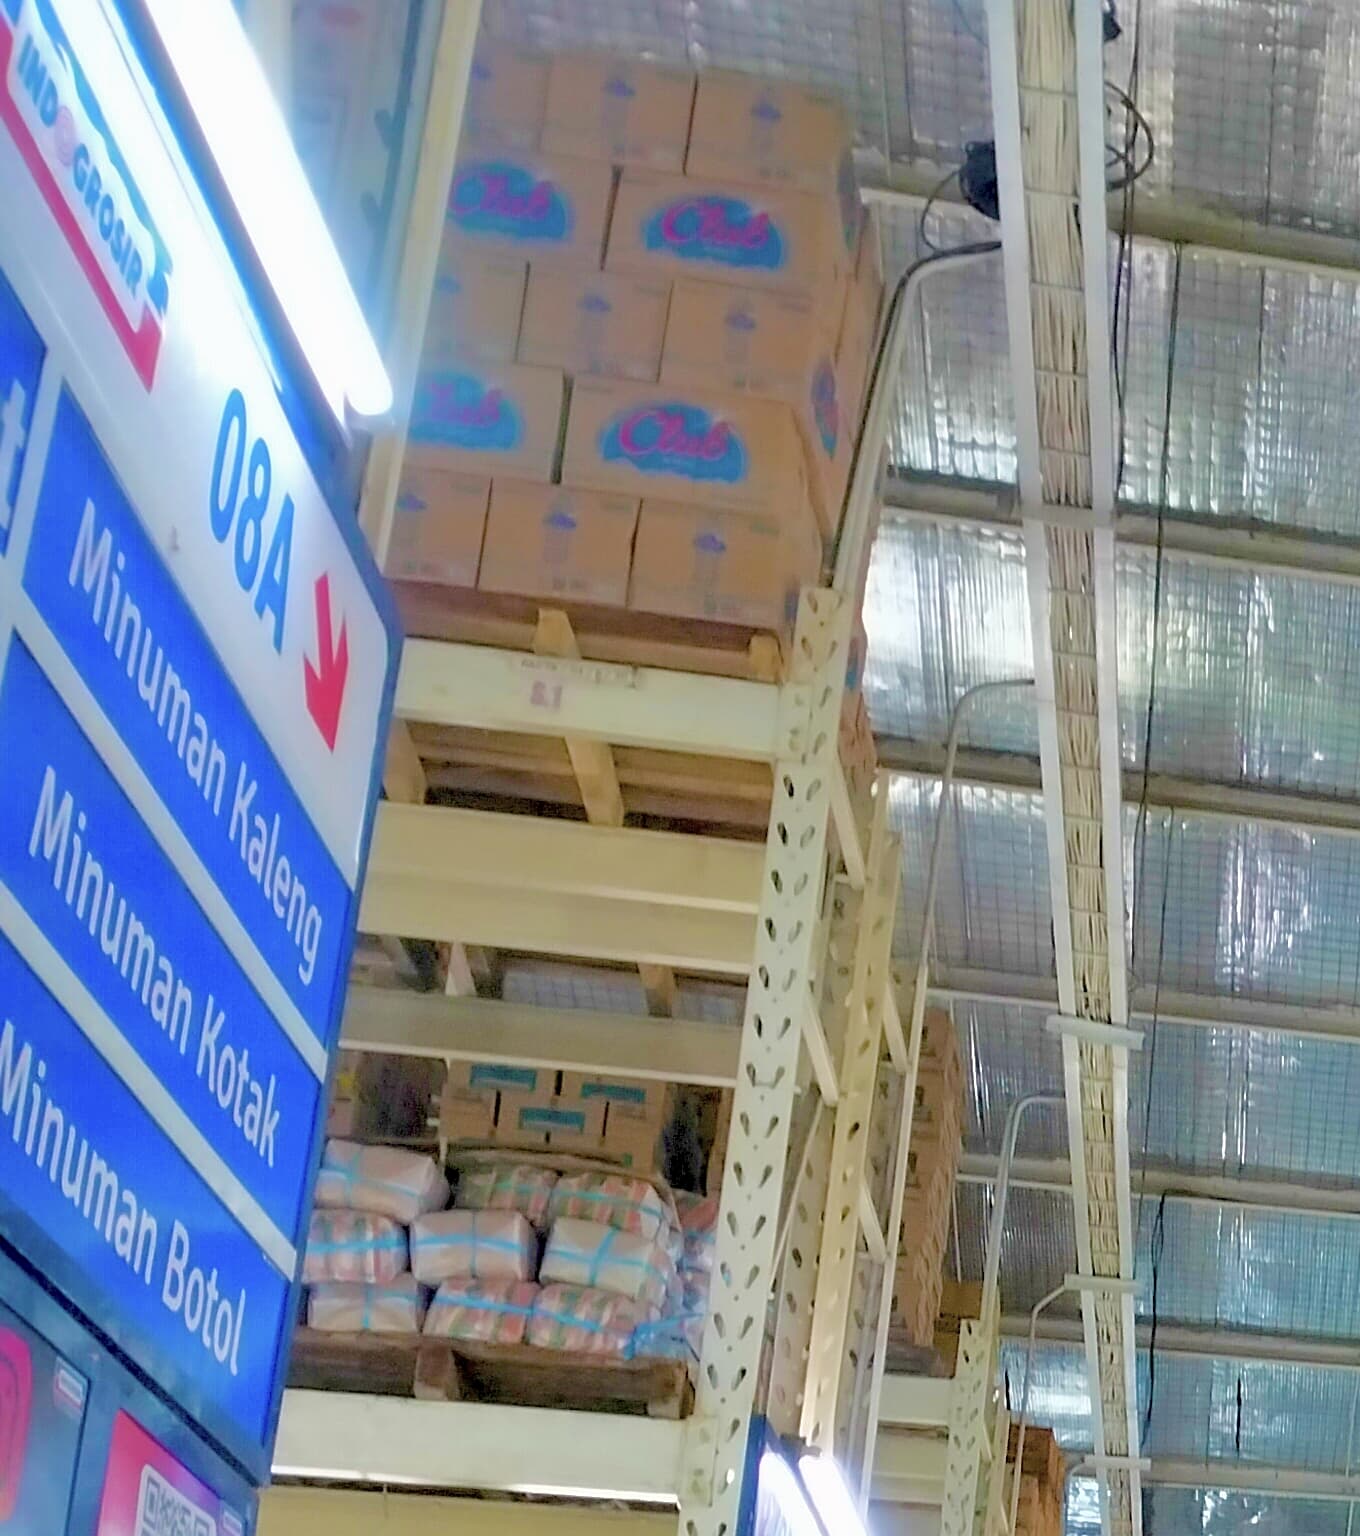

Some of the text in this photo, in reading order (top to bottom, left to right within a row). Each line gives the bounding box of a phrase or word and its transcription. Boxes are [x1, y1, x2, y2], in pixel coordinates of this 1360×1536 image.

[210, 388, 296, 655] 08A
[68, 497, 323, 987] Minuman Kaleng
[28, 764, 283, 1169] Minuman Kotak
[0, 1016, 247, 1377] Minuman Botol
